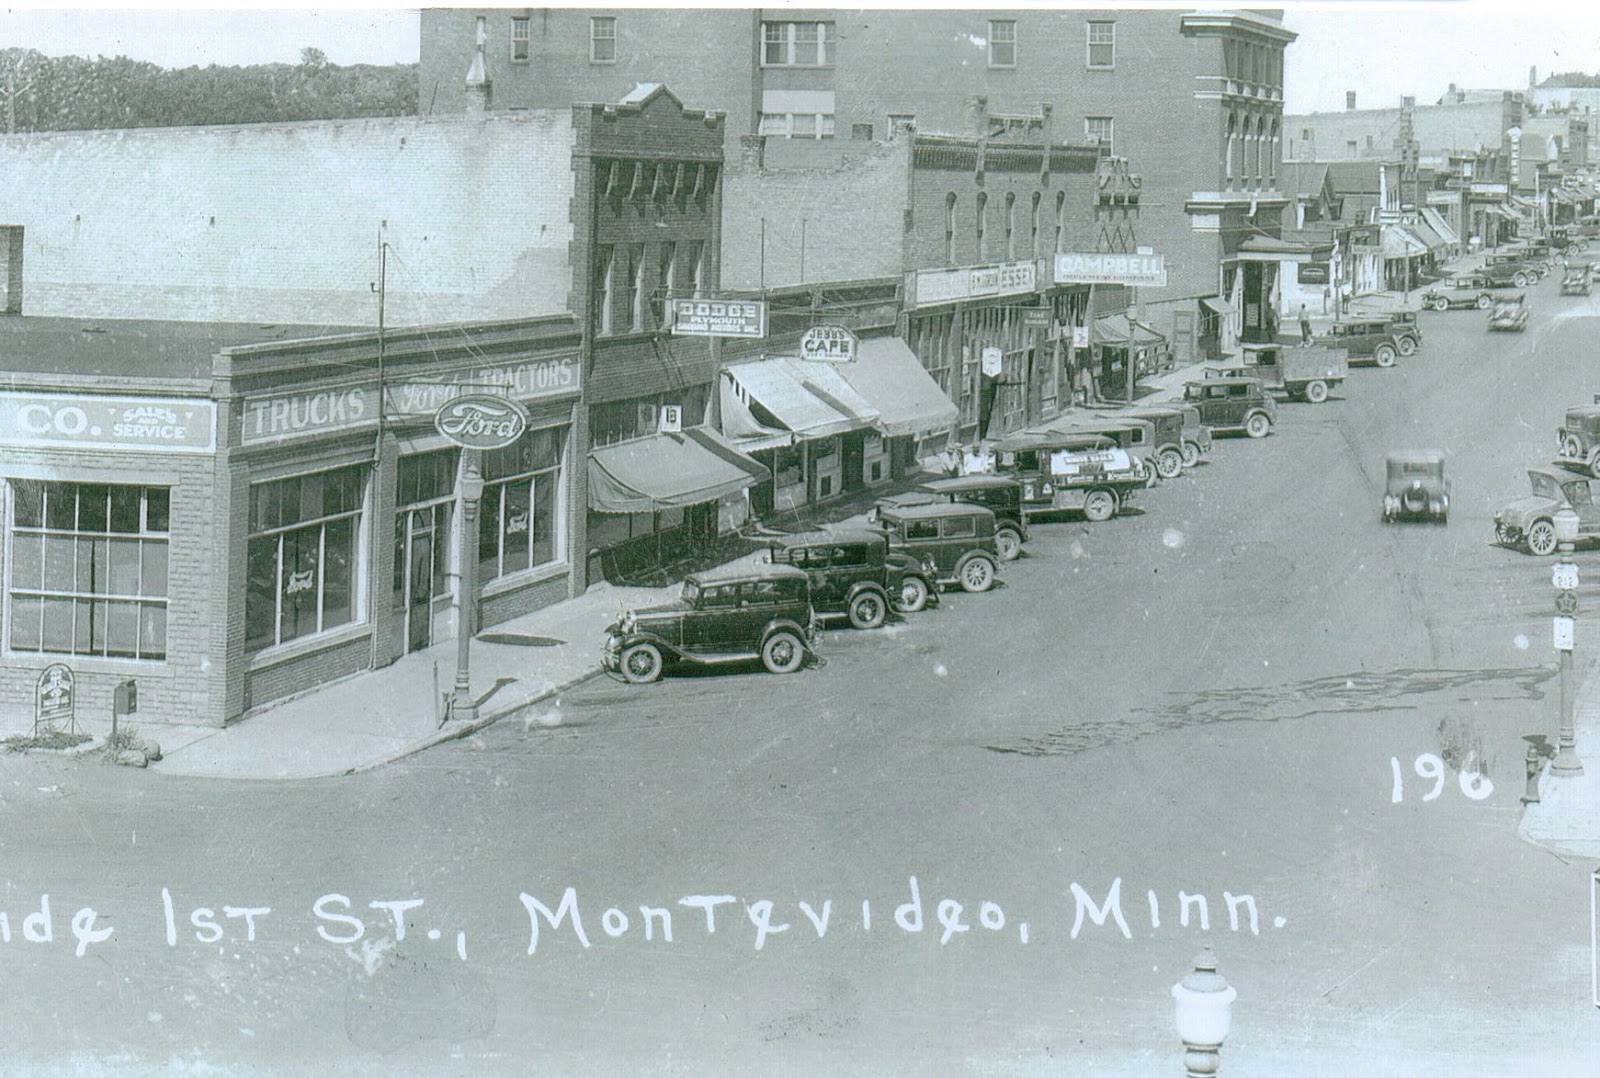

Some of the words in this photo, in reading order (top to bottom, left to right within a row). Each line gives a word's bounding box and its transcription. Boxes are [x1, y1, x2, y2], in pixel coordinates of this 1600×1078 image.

[1061, 257, 1160, 274] CAMPBELL
[679, 302, 756, 318] DODGE
[804, 340, 850, 353] CAFE
[479, 358, 572, 394] TRACTORS
[17, 404, 101, 436] CO.
[250, 388, 364, 434] TRUCKS
[441, 403, 520, 438] Ford
[112, 423, 187, 439] SERVICE
